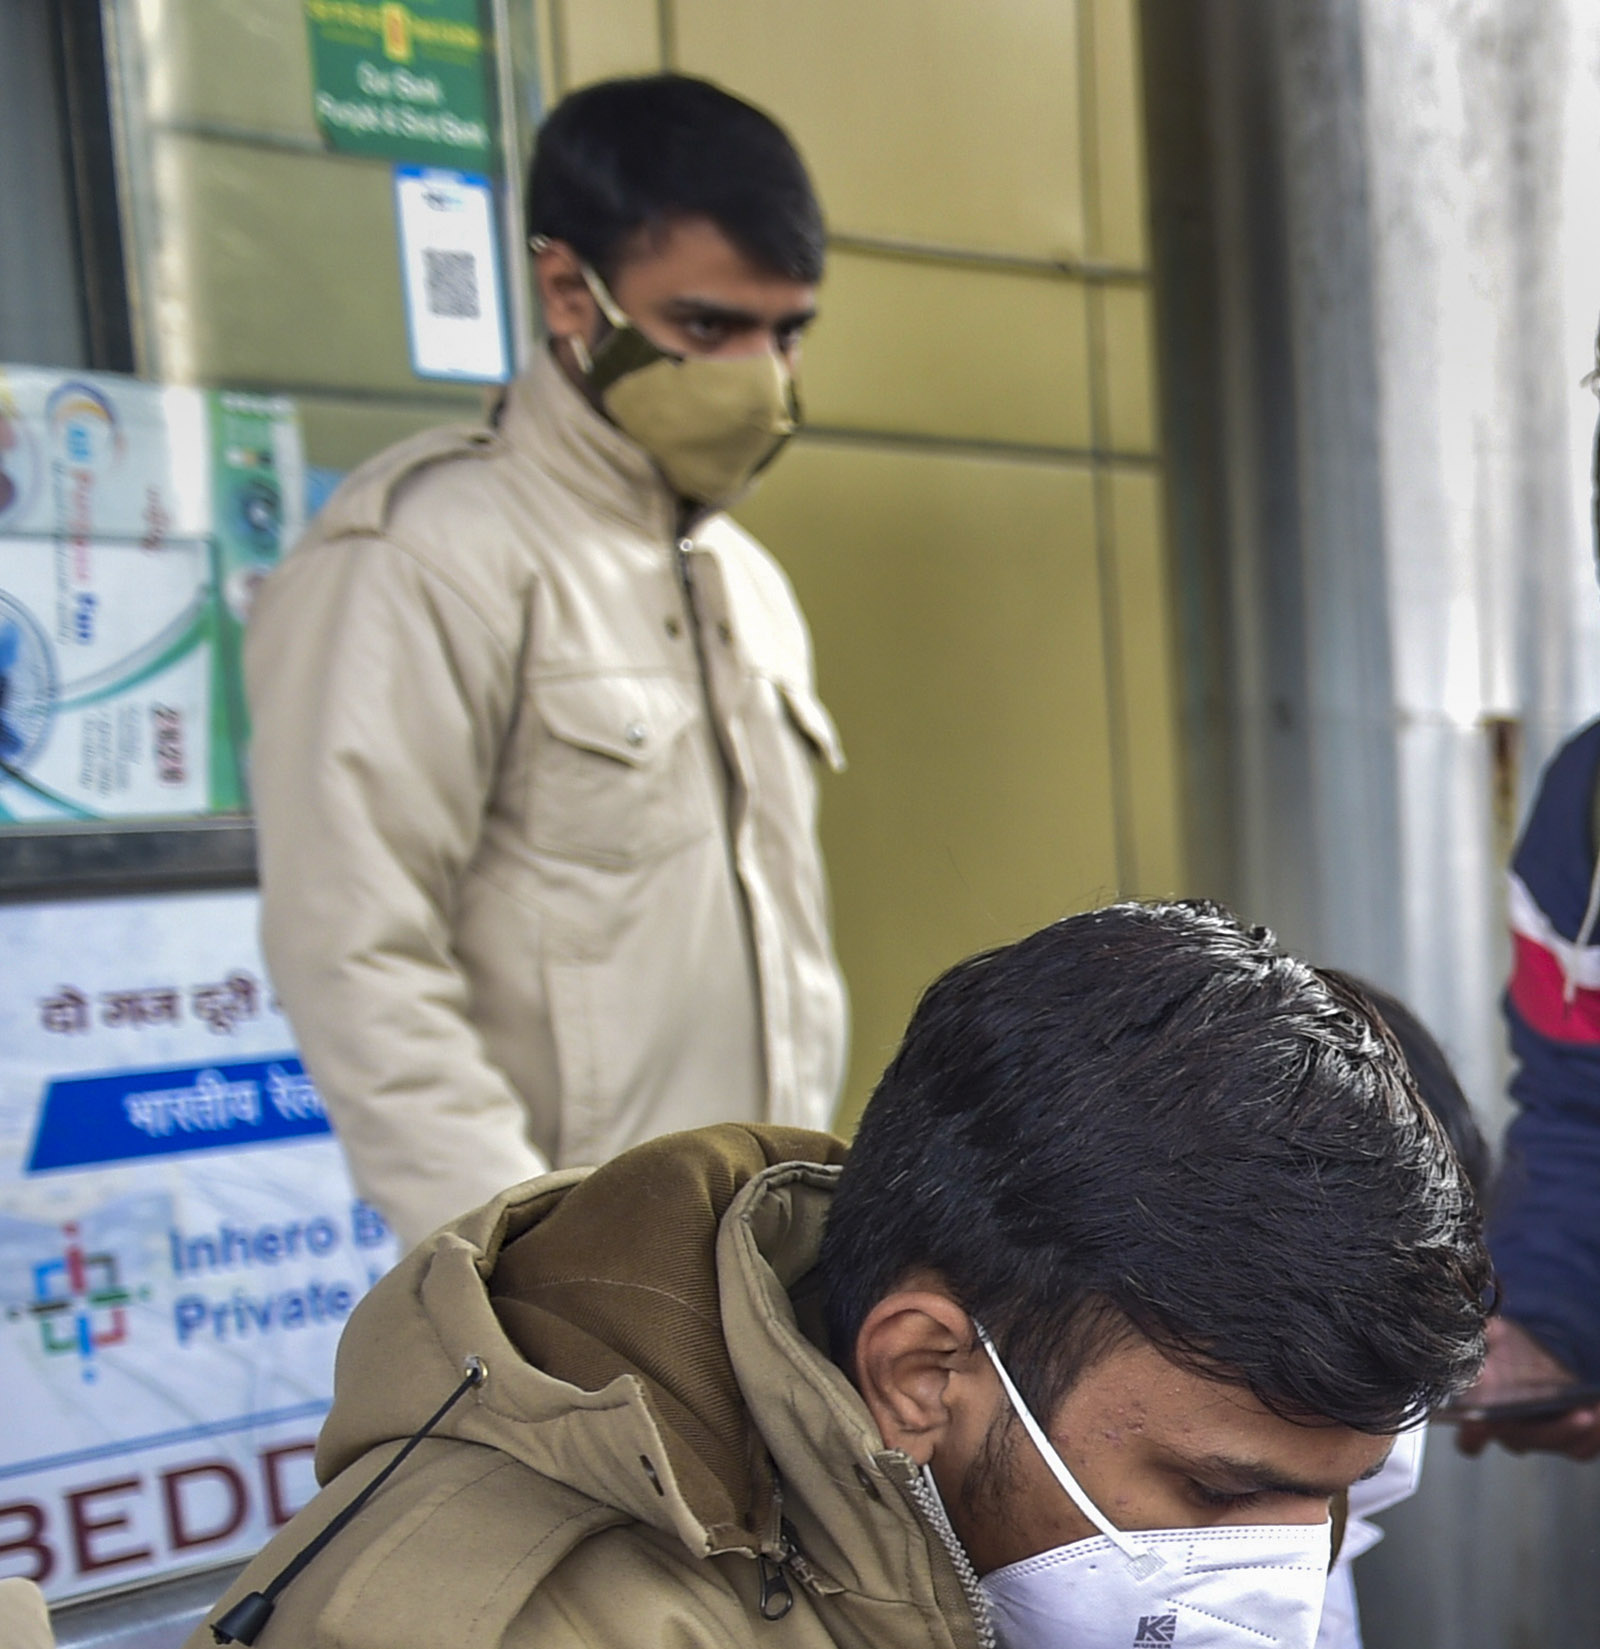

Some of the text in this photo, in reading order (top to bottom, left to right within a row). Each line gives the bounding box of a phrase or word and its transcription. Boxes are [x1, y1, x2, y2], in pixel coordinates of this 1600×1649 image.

[41, 969, 258, 1036] दो गज दूरी
[123, 1068, 263, 1138] भारतीय
[170, 1216, 339, 1274] Inhero
[174, 1278, 354, 1349] Private
